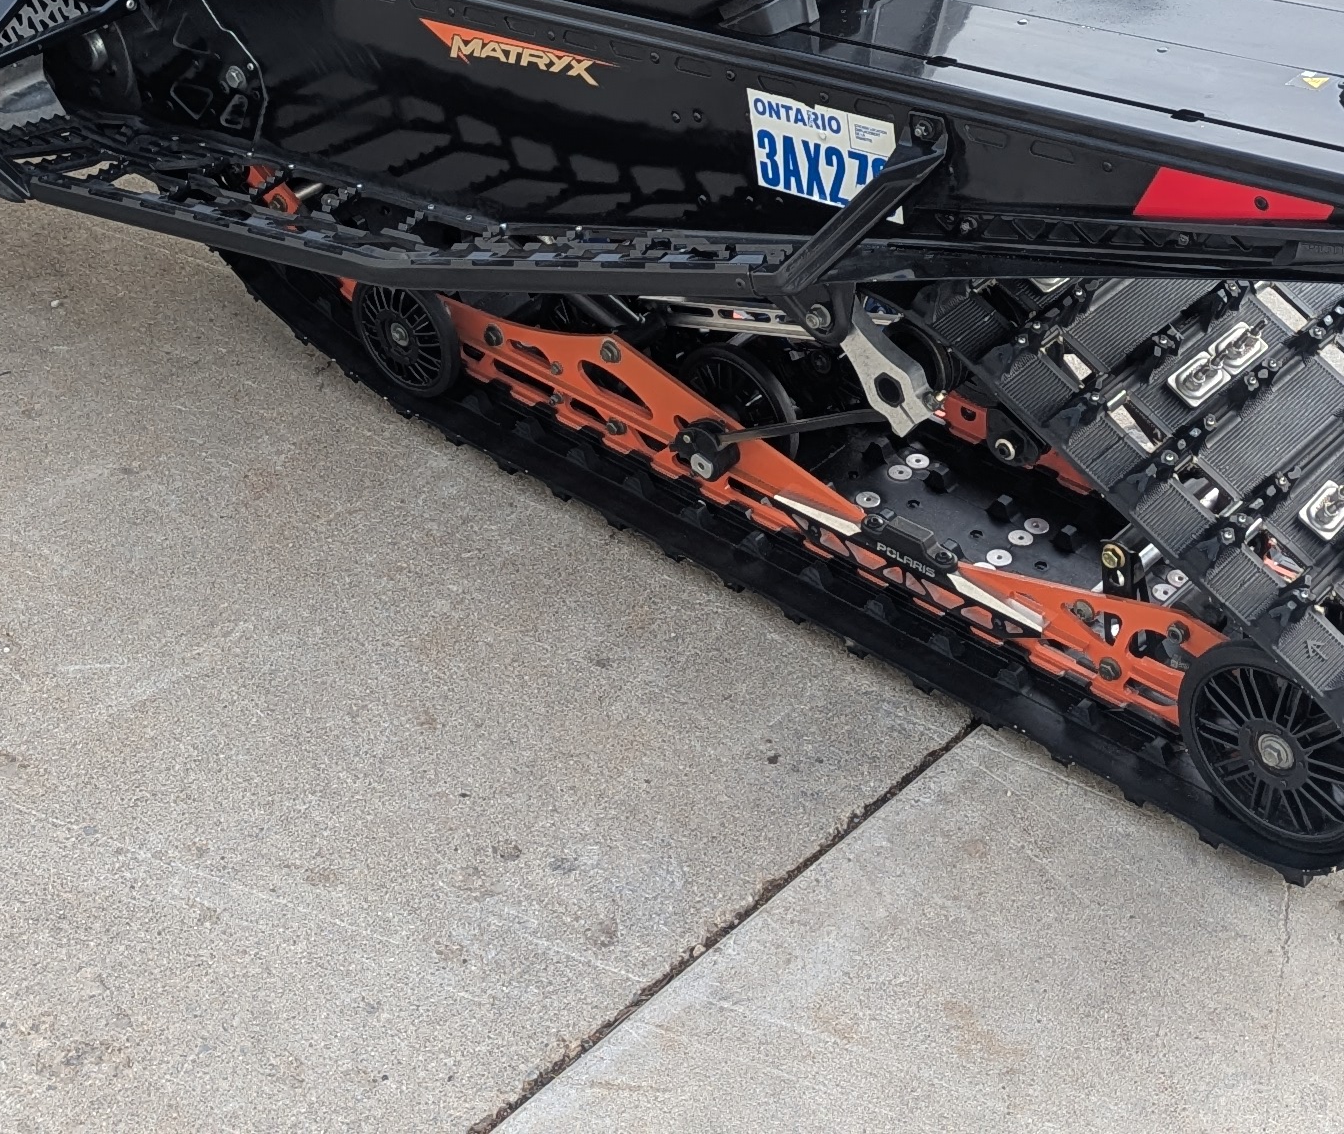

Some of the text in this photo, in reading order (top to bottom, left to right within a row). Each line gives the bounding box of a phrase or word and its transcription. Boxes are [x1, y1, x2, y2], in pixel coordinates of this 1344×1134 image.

[450, 34, 599, 87] MATRYX
[753, 97, 842, 135] ONTARIO
[876, 542, 936, 579] POLARIS
